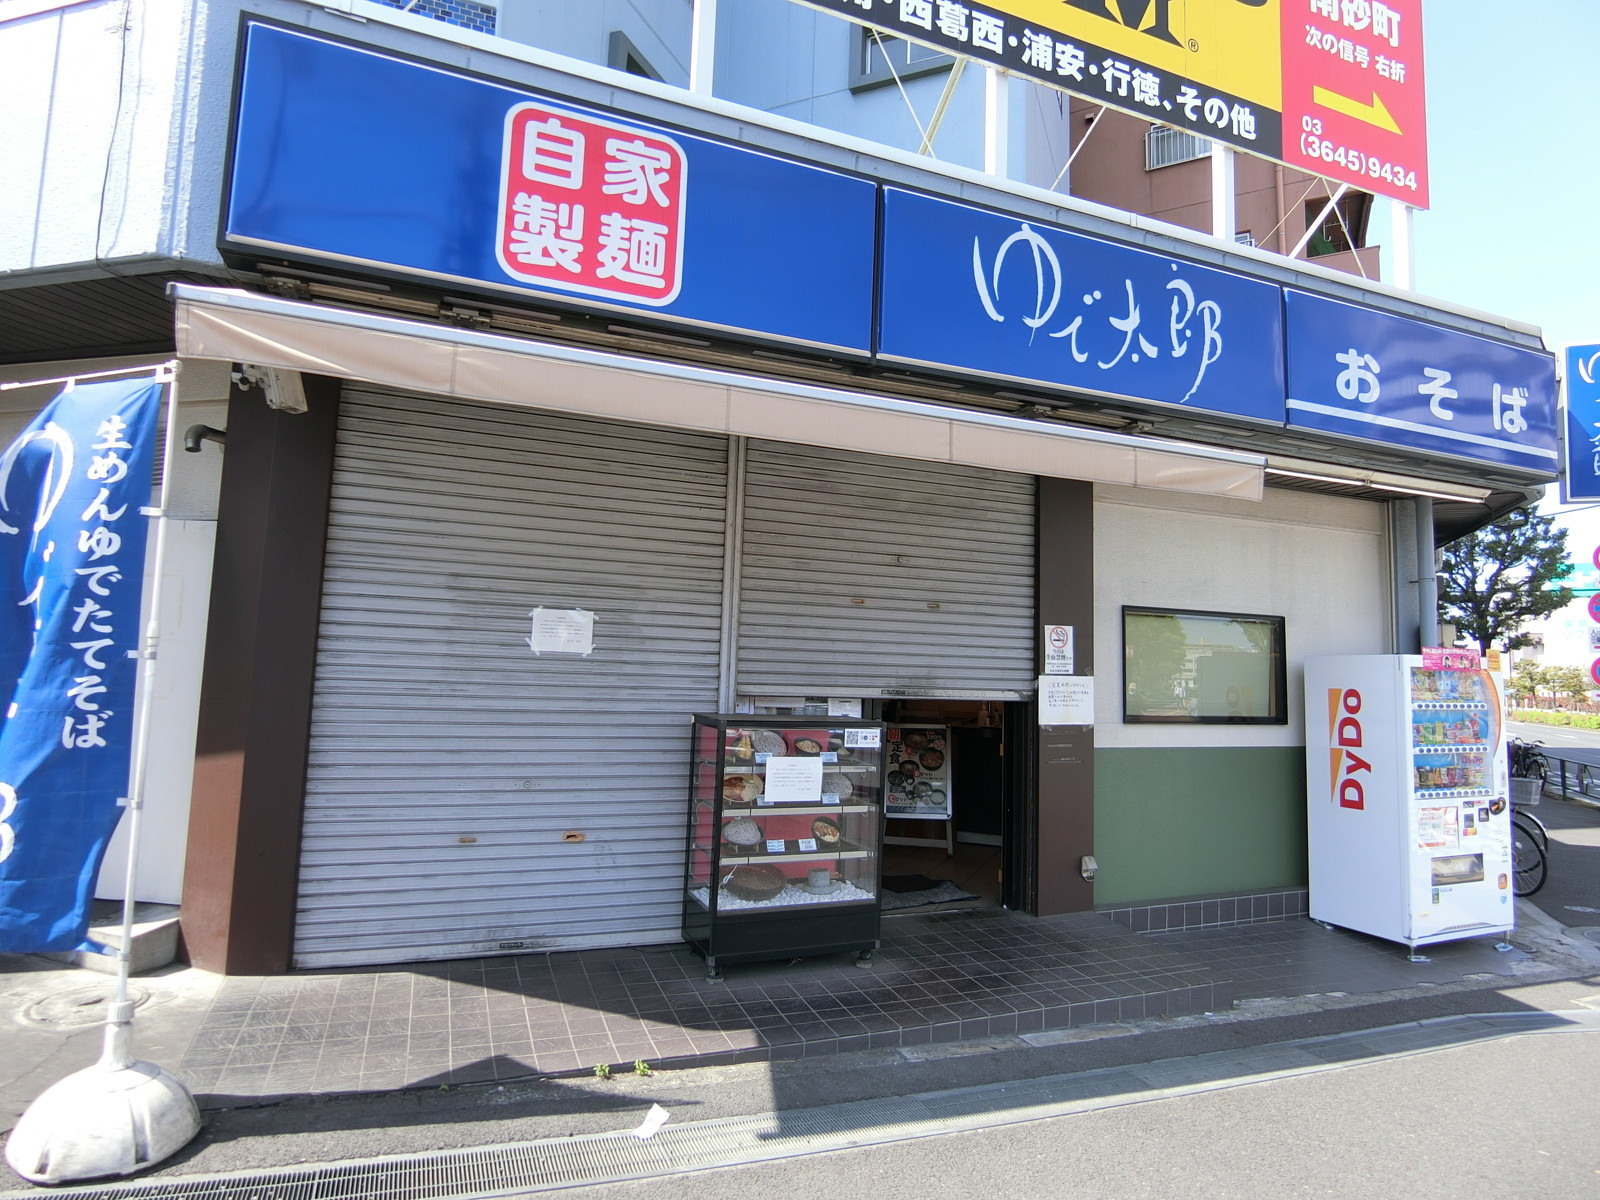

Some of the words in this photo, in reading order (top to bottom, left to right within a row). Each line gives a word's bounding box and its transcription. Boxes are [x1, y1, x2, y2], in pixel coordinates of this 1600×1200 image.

[843, 0, 1256, 141] ・西葛西・浦安・行徳、その他
[1305, 25, 1370, 68] 次の信号
[1375, 55, 1405, 84] 右折
[522, 117, 671, 208] 自家
[1300, 132, 1417, 191] (3645)9434
[1302, 115, 1322, 135] 03
[509, 192, 669, 289] 製麺
[973, 223, 1222, 403] ゆで太郎
[1335, 348, 1529, 434] おそば
[62, 415, 131, 750] 生めんゆでたてそば
[1339, 687, 1372, 811] DyDo
